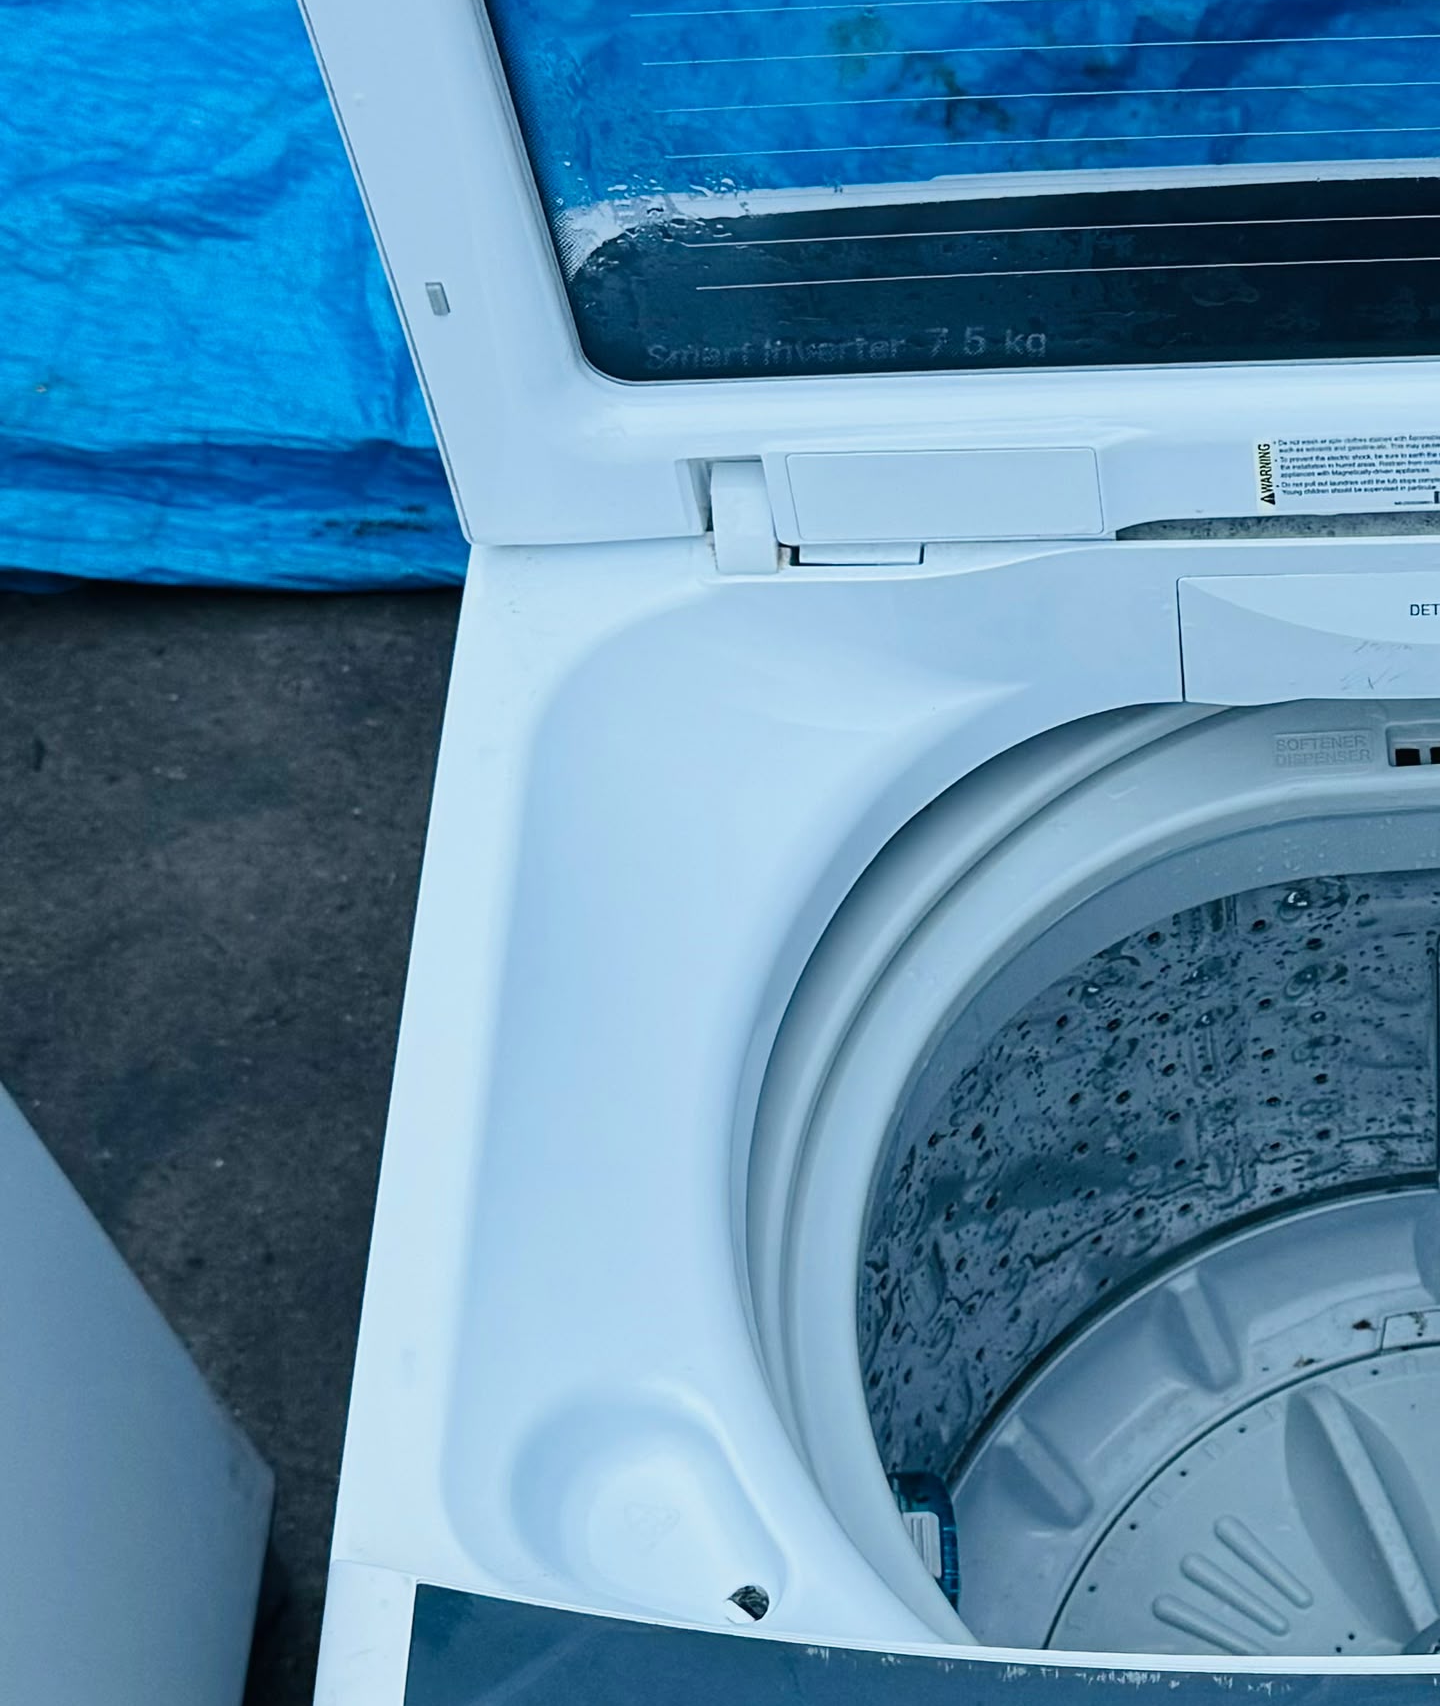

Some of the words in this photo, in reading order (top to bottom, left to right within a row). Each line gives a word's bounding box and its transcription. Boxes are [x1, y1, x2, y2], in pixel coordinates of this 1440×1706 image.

[1258, 443, 1275, 494] WARNING
[1276, 734, 1367, 752] SOFTENER
[1276, 749, 1371, 768] DISPENSER
